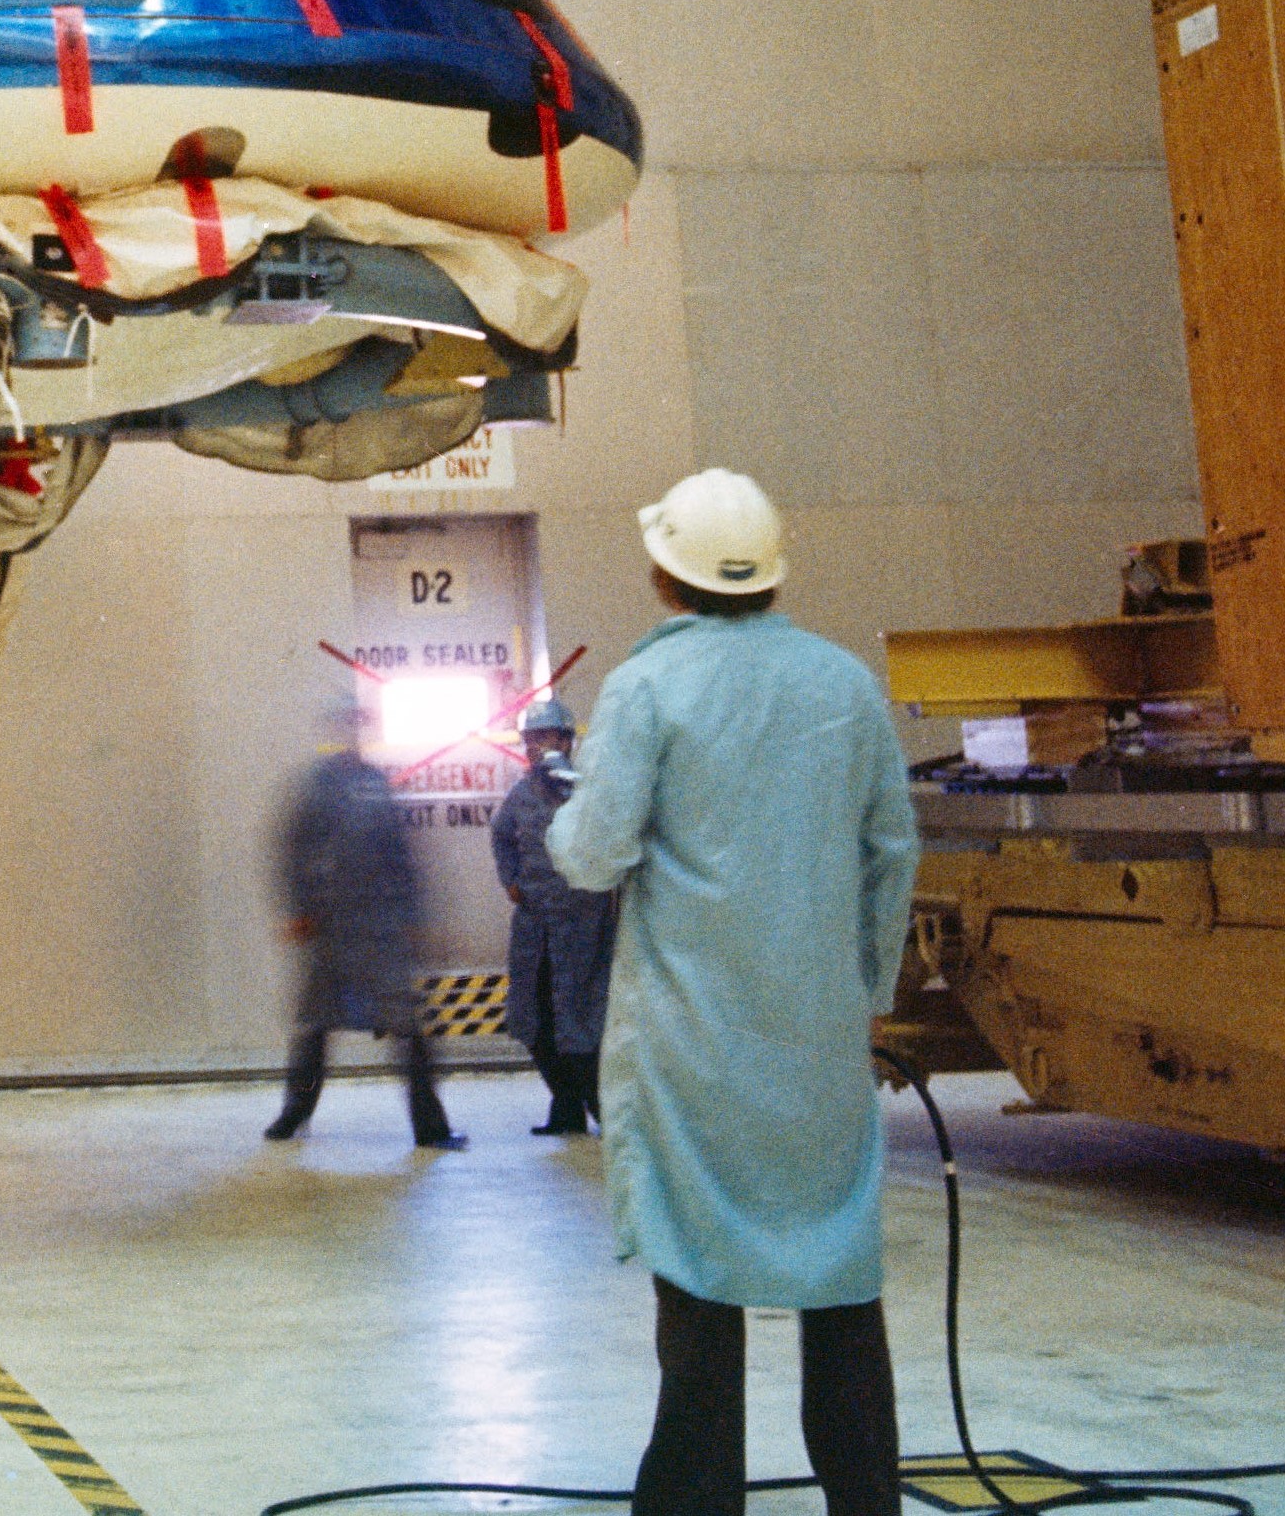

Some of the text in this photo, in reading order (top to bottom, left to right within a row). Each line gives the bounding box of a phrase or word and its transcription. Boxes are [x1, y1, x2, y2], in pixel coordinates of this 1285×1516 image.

[445, 455, 490, 480] ONLY
[354, 642, 508, 668] DOOR SEALED
[391, 762, 496, 793] ERGENCY
